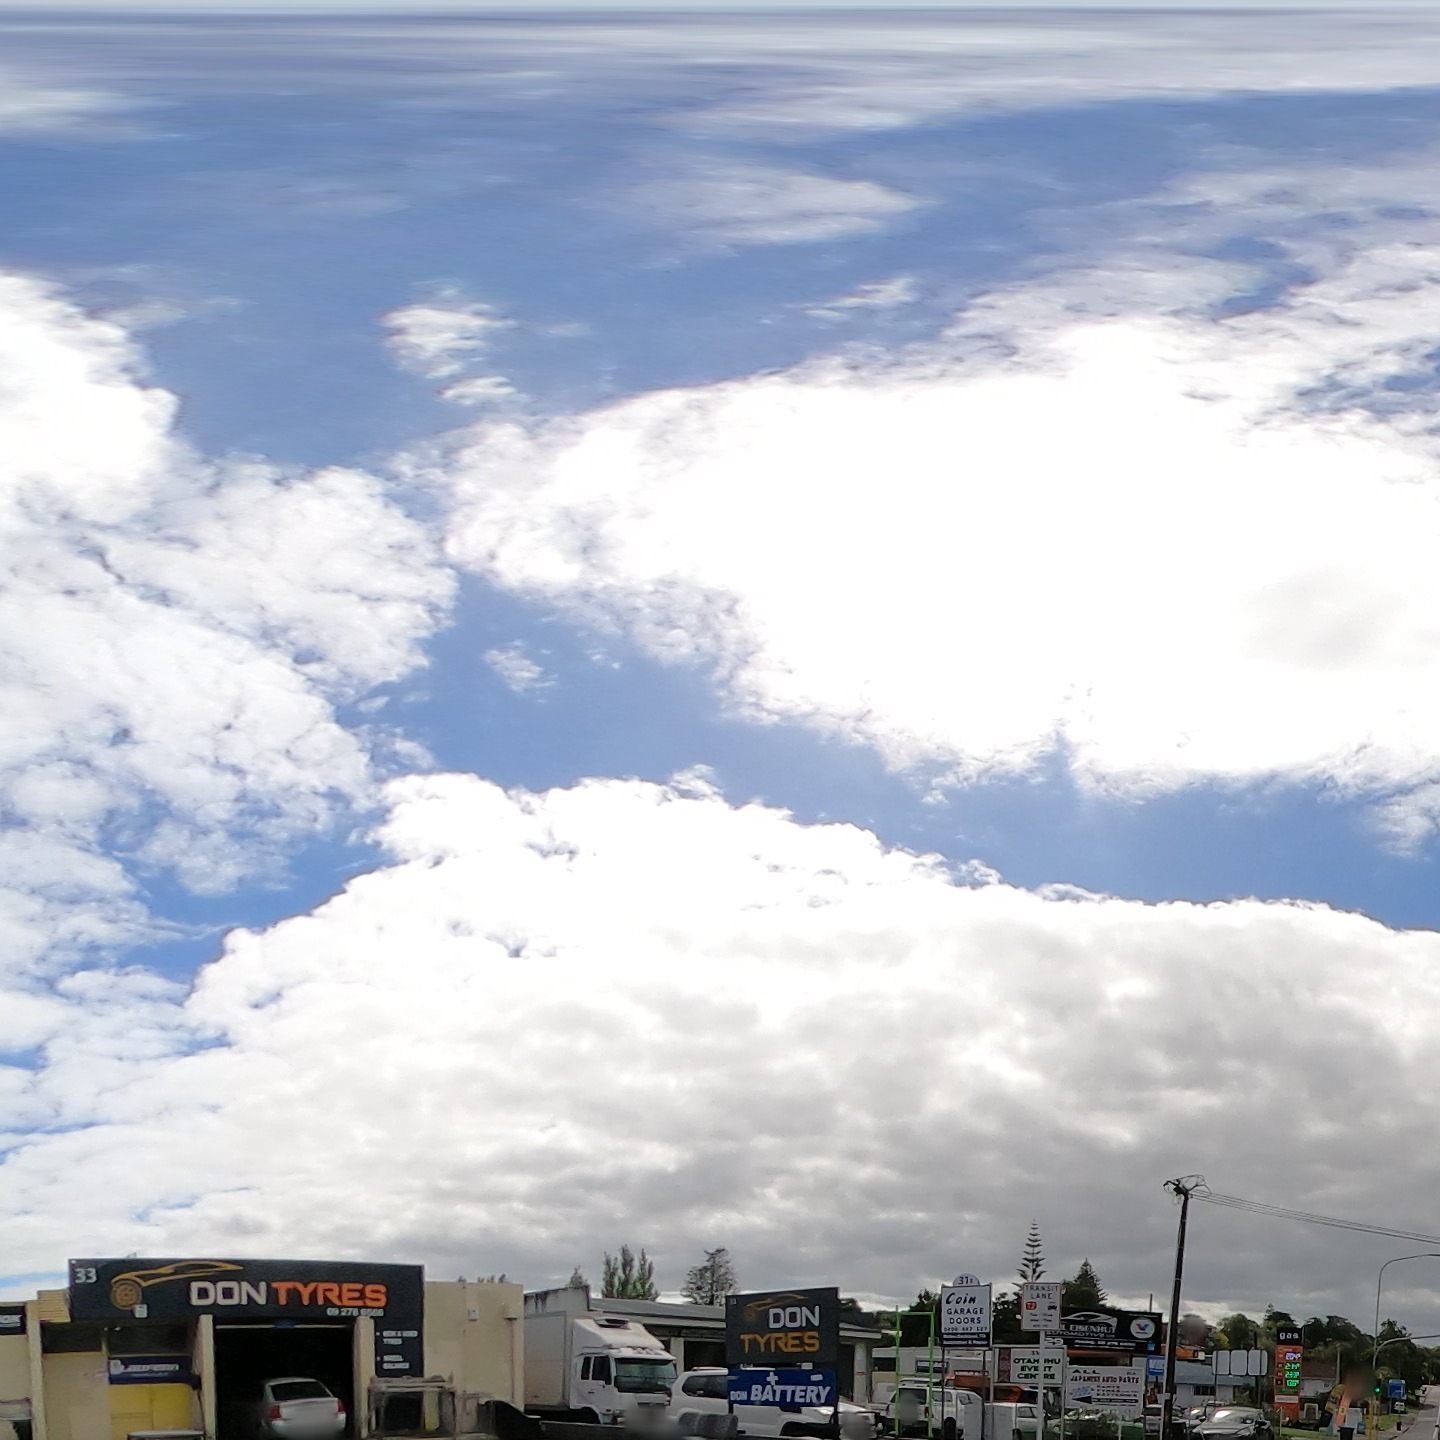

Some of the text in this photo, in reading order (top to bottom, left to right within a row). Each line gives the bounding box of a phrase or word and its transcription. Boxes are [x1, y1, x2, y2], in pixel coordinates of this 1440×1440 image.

[74, 1268, 97, 1283] 33
[189, 1281, 389, 1308] DON TYRES
[1025, 1284, 1059, 1292] TRANSIT
[945, 1292, 977, 1305] Coin
[768, 1305, 820, 1329] DON
[946, 1307, 984, 1315] GARAGE
[949, 1316, 982, 1325] DOORS
[740, 1331, 821, 1355] TYRES
[730, 1384, 831, 1403] DON BATTERY
